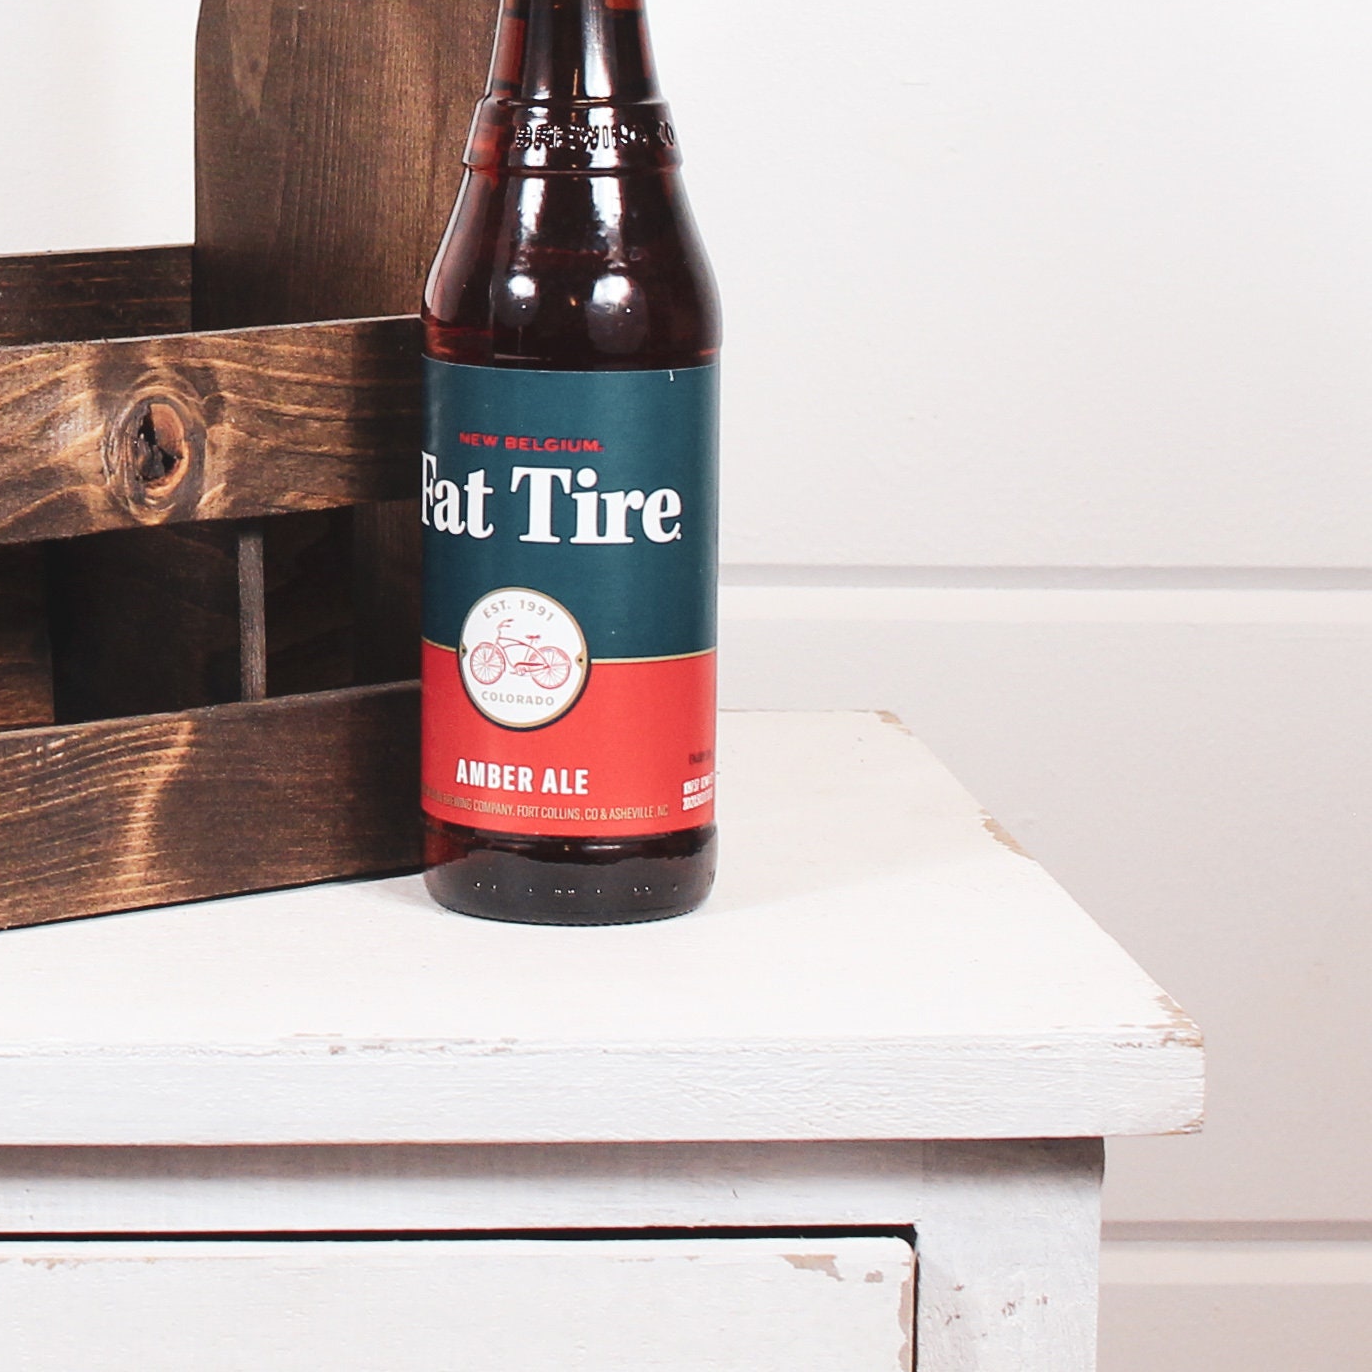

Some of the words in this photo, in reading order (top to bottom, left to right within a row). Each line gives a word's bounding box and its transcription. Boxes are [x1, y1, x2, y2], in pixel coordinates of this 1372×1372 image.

[459, 432, 499, 447] NEW
[421, 450, 495, 539] Fat
[510, 466, 682, 544] Tire
[483, 599, 511, 619] EST.
[519, 599, 555, 621] 1991
[481, 691, 555, 706] COLORADO
[455, 758, 533, 793] AMBER
[541, 768, 589, 795] ALE
[517, 804, 539, 818] FORT
[584, 807, 599, 821] CO
[600, 807, 608, 821] &
[658, 803, 669, 816] NC
